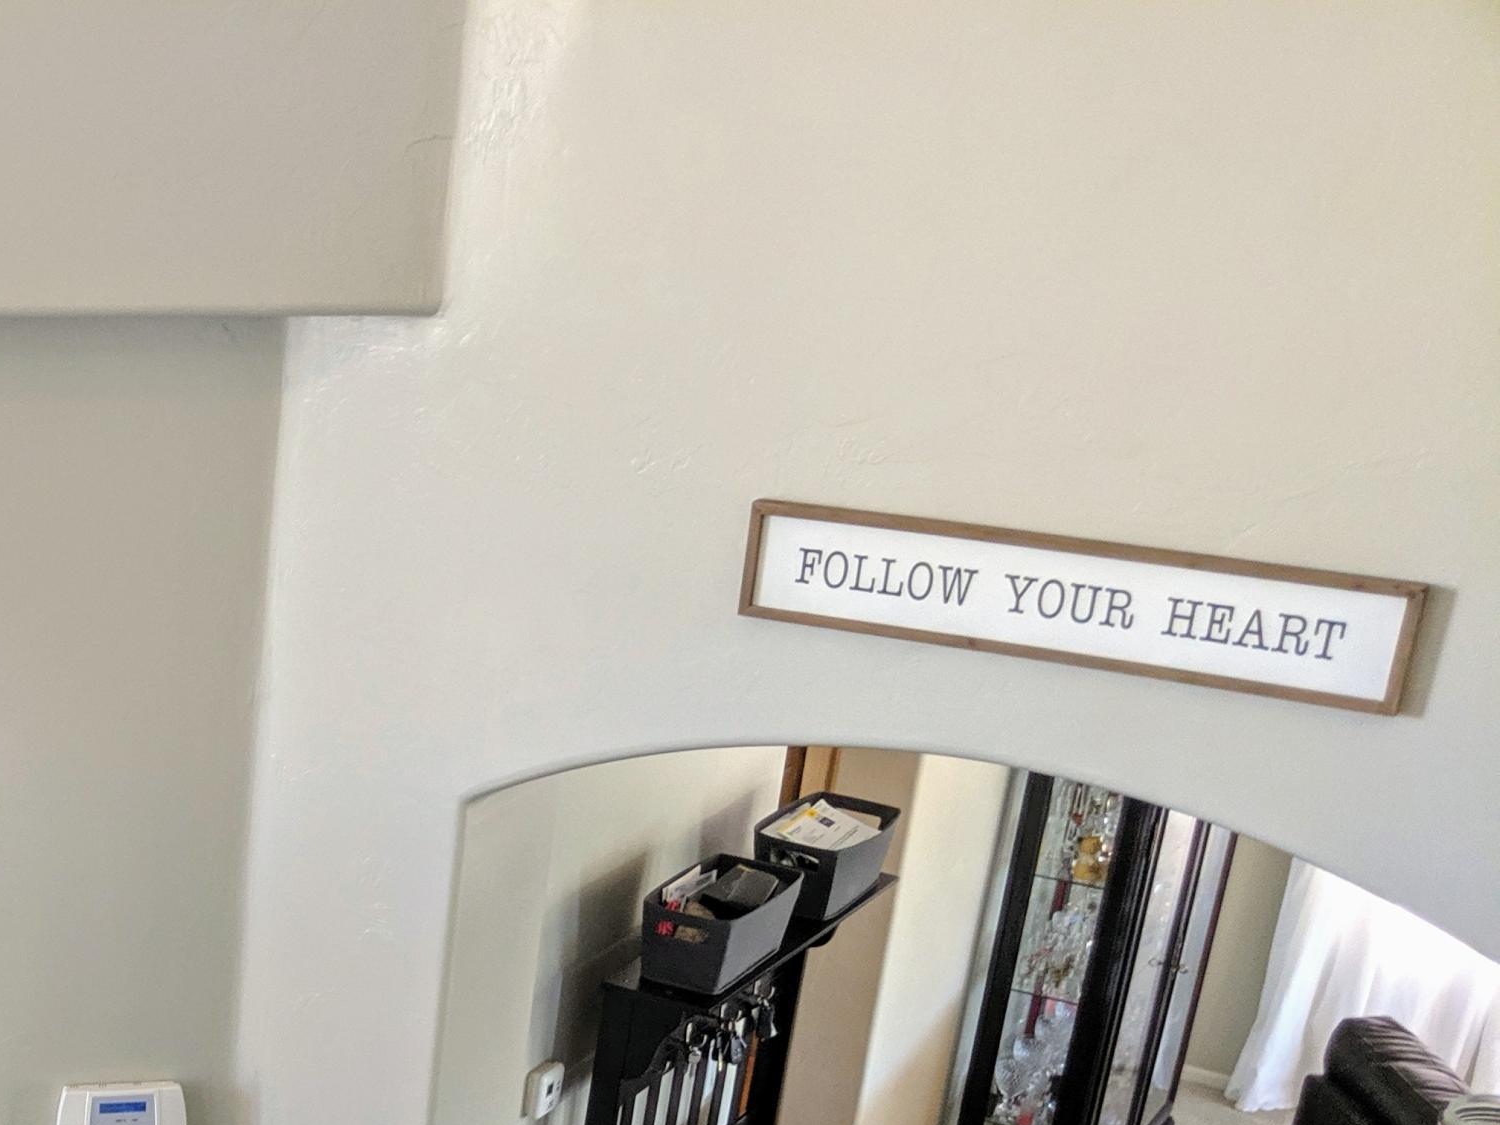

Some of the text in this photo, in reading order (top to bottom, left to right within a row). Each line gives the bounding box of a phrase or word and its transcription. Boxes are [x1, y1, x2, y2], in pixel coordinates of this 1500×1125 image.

[794, 547, 1348, 662] FOLLOW YOUR HEART
